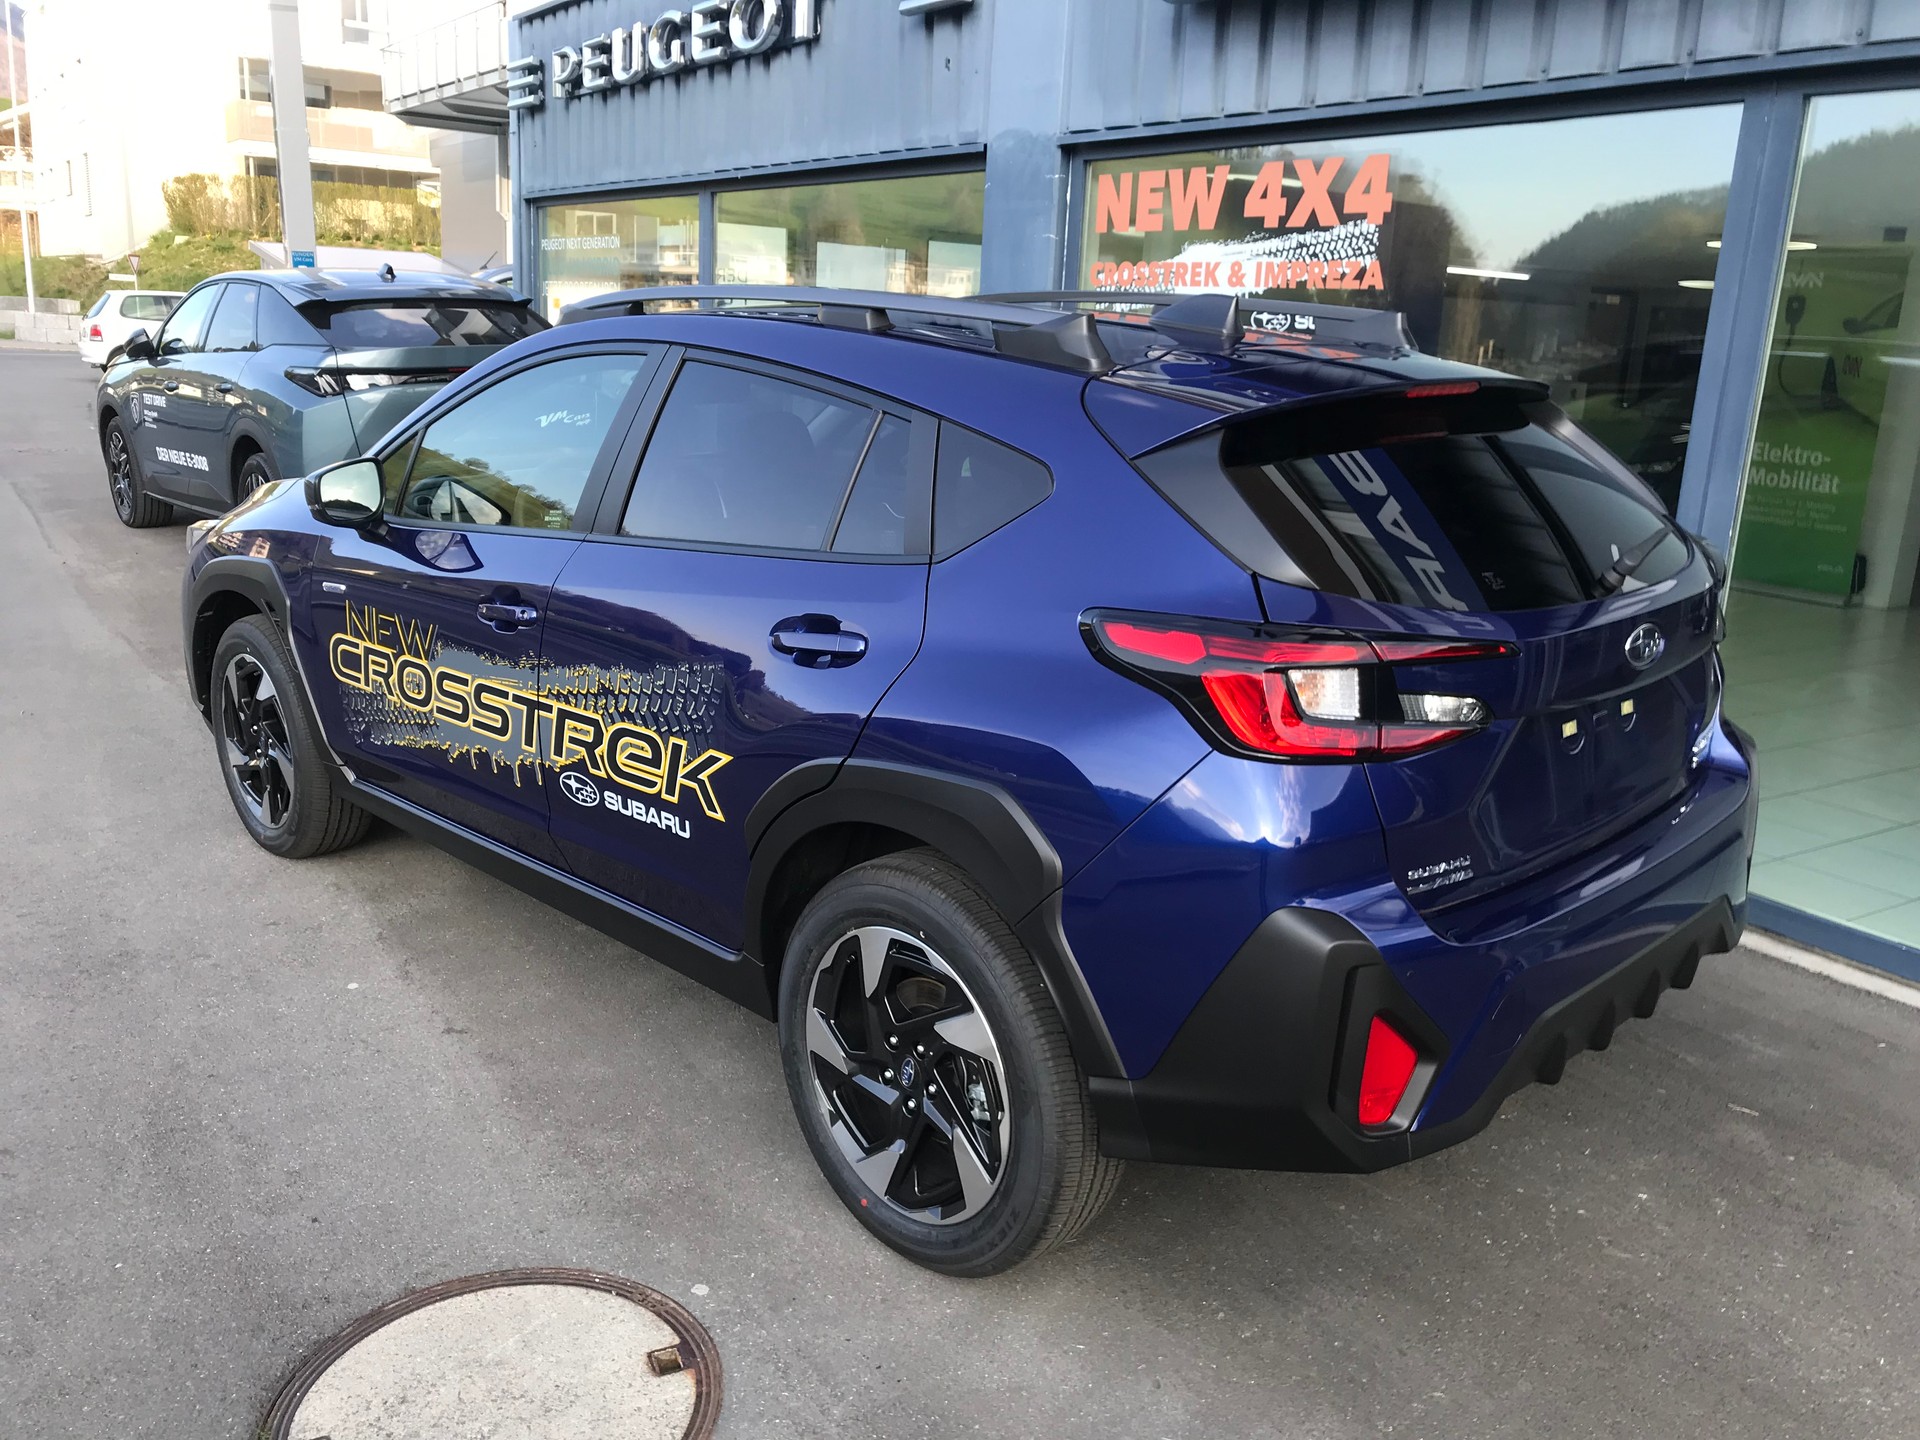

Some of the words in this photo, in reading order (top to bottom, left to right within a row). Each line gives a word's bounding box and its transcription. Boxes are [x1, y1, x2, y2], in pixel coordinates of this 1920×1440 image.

[1095, 164, 1231, 234] NEW
[1243, 153, 1393, 229] 4X4
[541, 238, 566, 251] PEUGEOT
[566, 237, 581, 250] NEXT
[582, 235, 620, 250] GENERATION
[1090, 260, 1222, 288] CROSSTREK
[1227, 260, 1246, 288] &
[1254, 259, 1385, 290] IMPREZA
[155, 446, 170, 462] DER
[168, 449, 188, 466] NEUE
[1751, 441, 1831, 467] Elektro-
[1747, 465, 1841, 494] Mobilität
[345, 599, 439, 661] NEW
[604, 790, 691, 839] SUBARU
